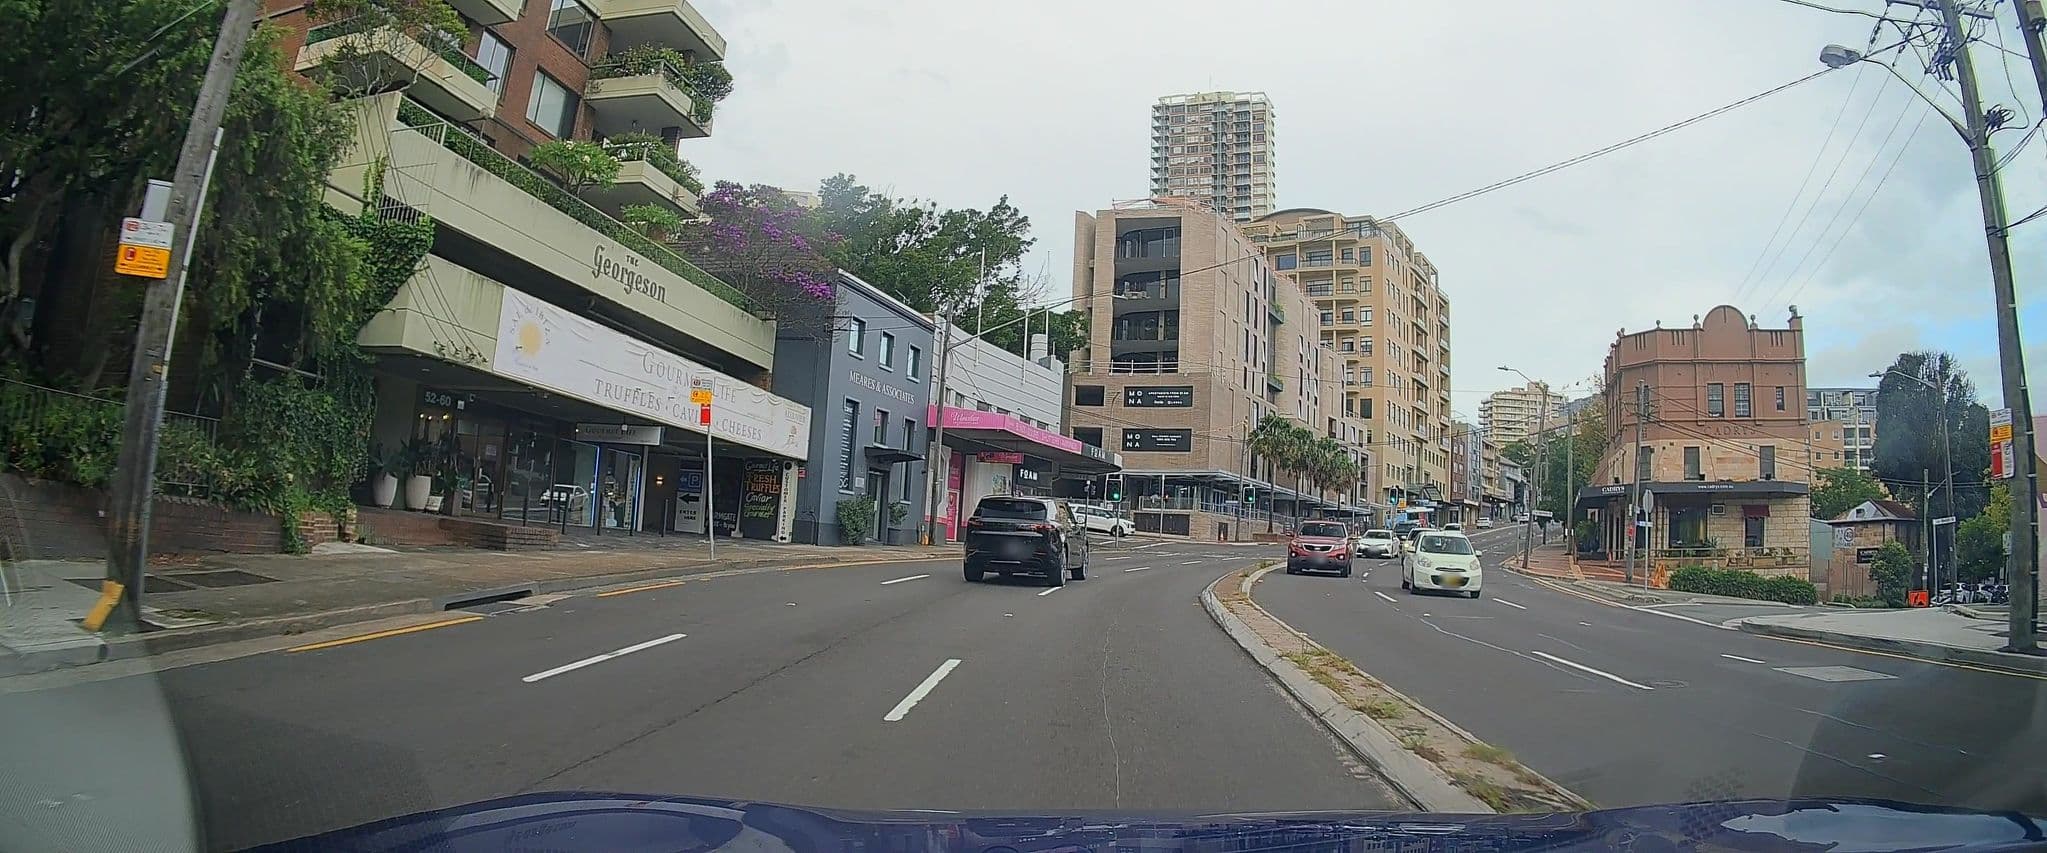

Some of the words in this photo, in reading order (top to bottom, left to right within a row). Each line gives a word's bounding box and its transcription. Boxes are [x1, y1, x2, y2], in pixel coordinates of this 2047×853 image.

[592, 245, 666, 303] Georgeson
[424, 391, 452, 407] 52-60
[849, 370, 876, 390] MEARES
[875, 383, 882, 393] &
[881, 384, 915, 405] ASSOCIATES
[595, 378, 661, 412] TRUFFLES
[672, 404, 699, 424] CAVI
[722, 418, 763, 441] CHEESES
[1090, 447, 1106, 460] FOAM
[1020, 468, 1038, 481] FOAM
